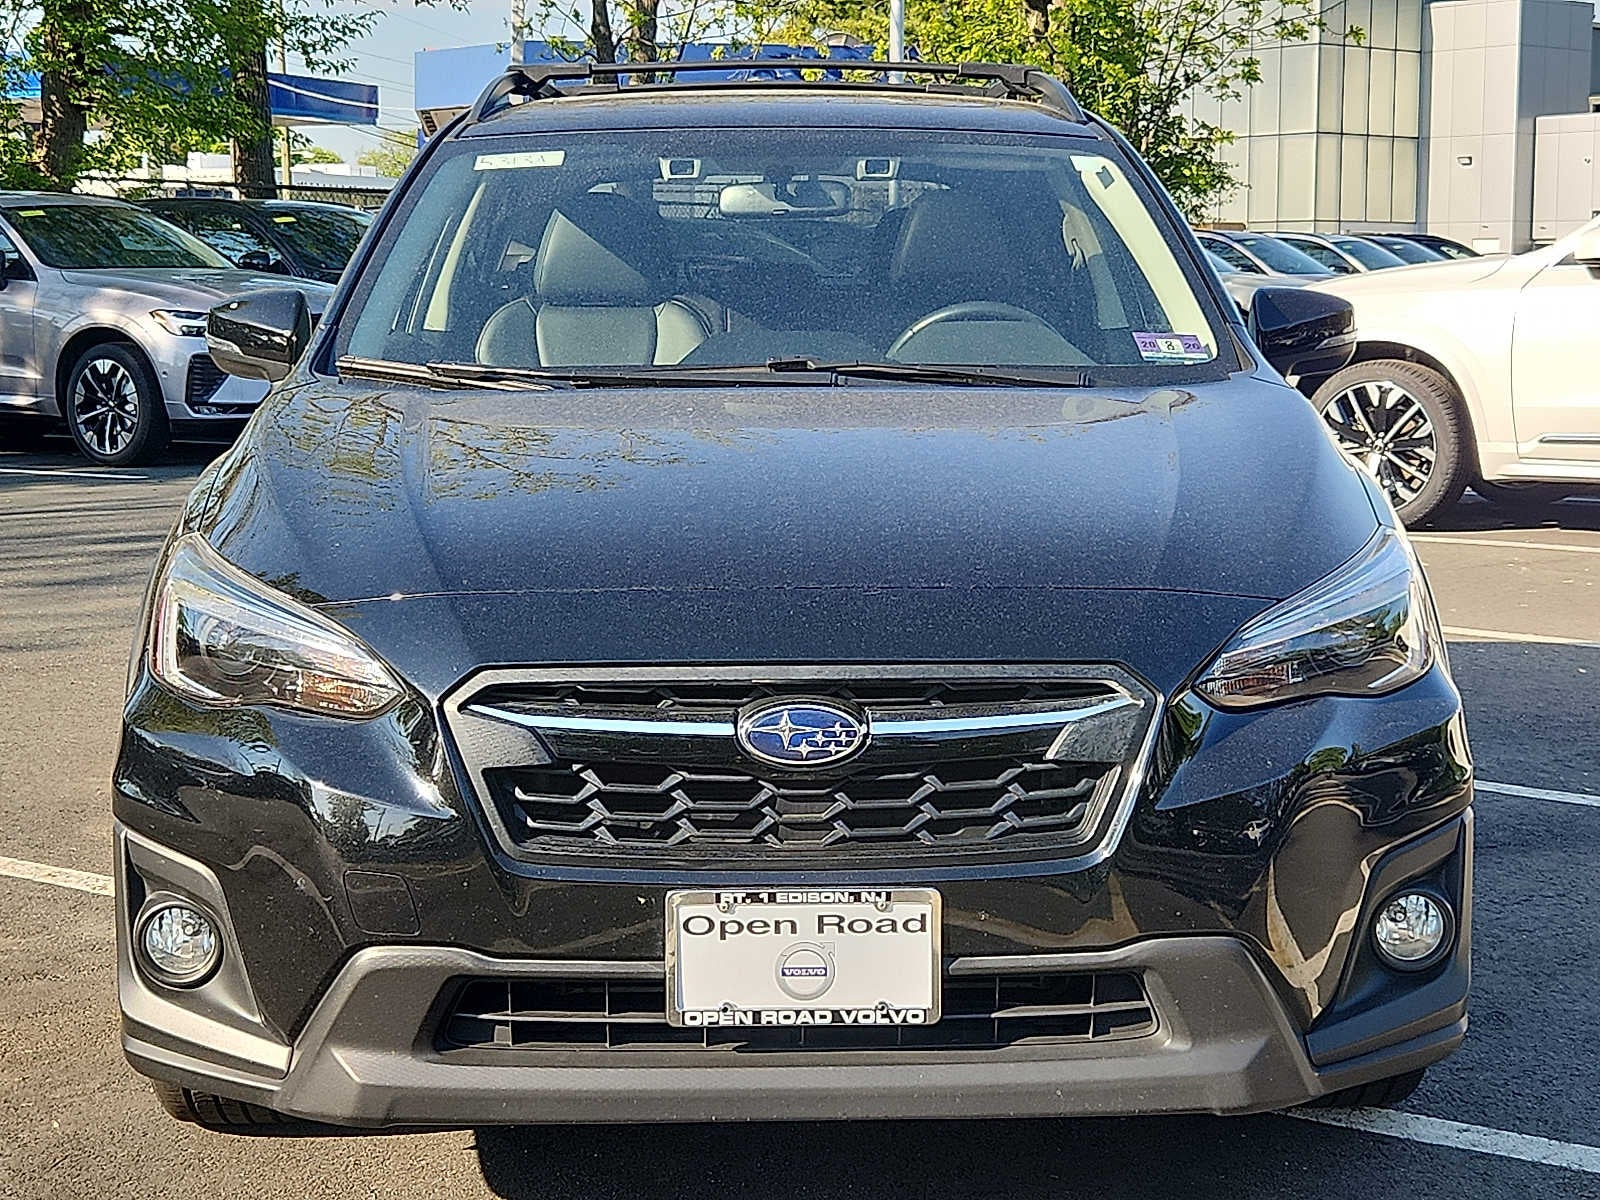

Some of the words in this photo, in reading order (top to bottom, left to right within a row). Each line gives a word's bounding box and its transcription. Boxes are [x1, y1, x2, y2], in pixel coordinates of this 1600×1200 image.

[1141, 341, 1157, 349] 20
[720, 892, 751, 905] RT.
[759, 893, 769, 903] 1
[860, 893, 888, 904] NJ
[682, 915, 798, 941] Open
[817, 913, 928, 934] Road
[783, 967, 827, 976] VOLVO
[683, 1011, 753, 1025] OPEN
[761, 1011, 832, 1025] ROAD
[842, 1010, 926, 1024] VOLVO
